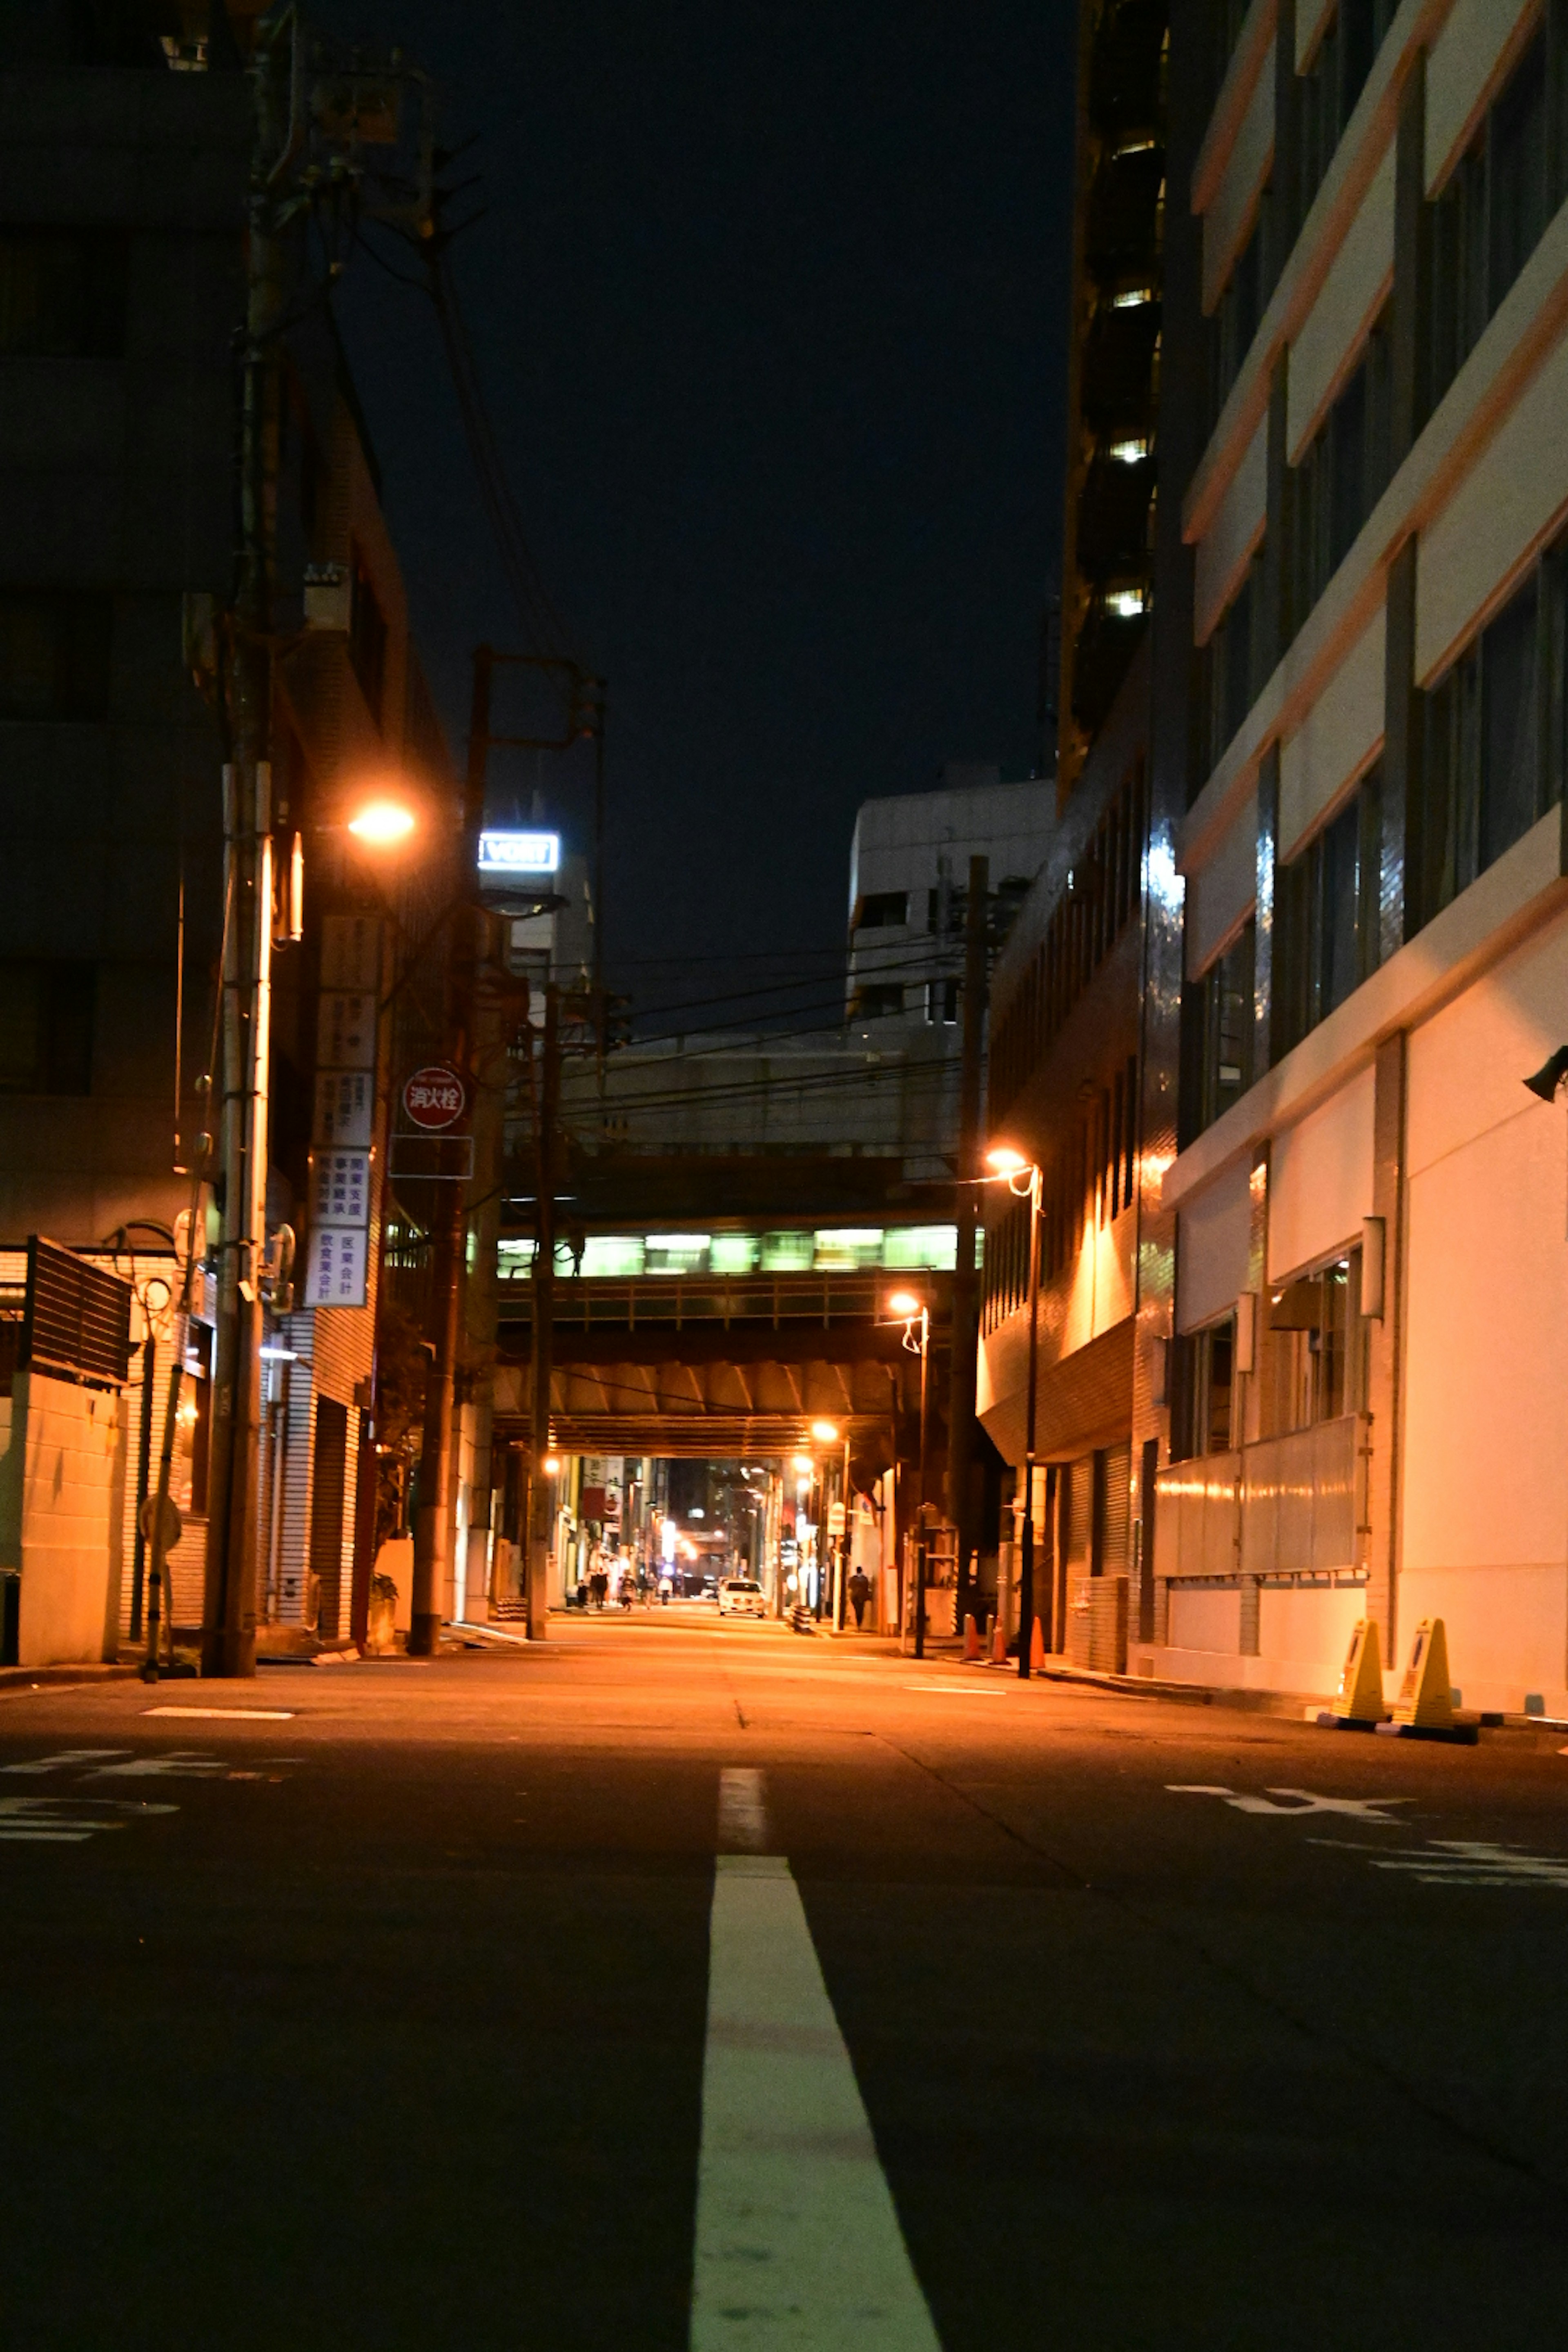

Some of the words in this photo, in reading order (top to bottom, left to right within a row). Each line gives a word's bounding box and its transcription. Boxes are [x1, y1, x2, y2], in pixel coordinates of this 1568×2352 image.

[410, 1086, 459, 1110] 消火栓
[318, 1234, 333, 1299] 飲食業会計
[340, 1237, 354, 1294] 医業会計
